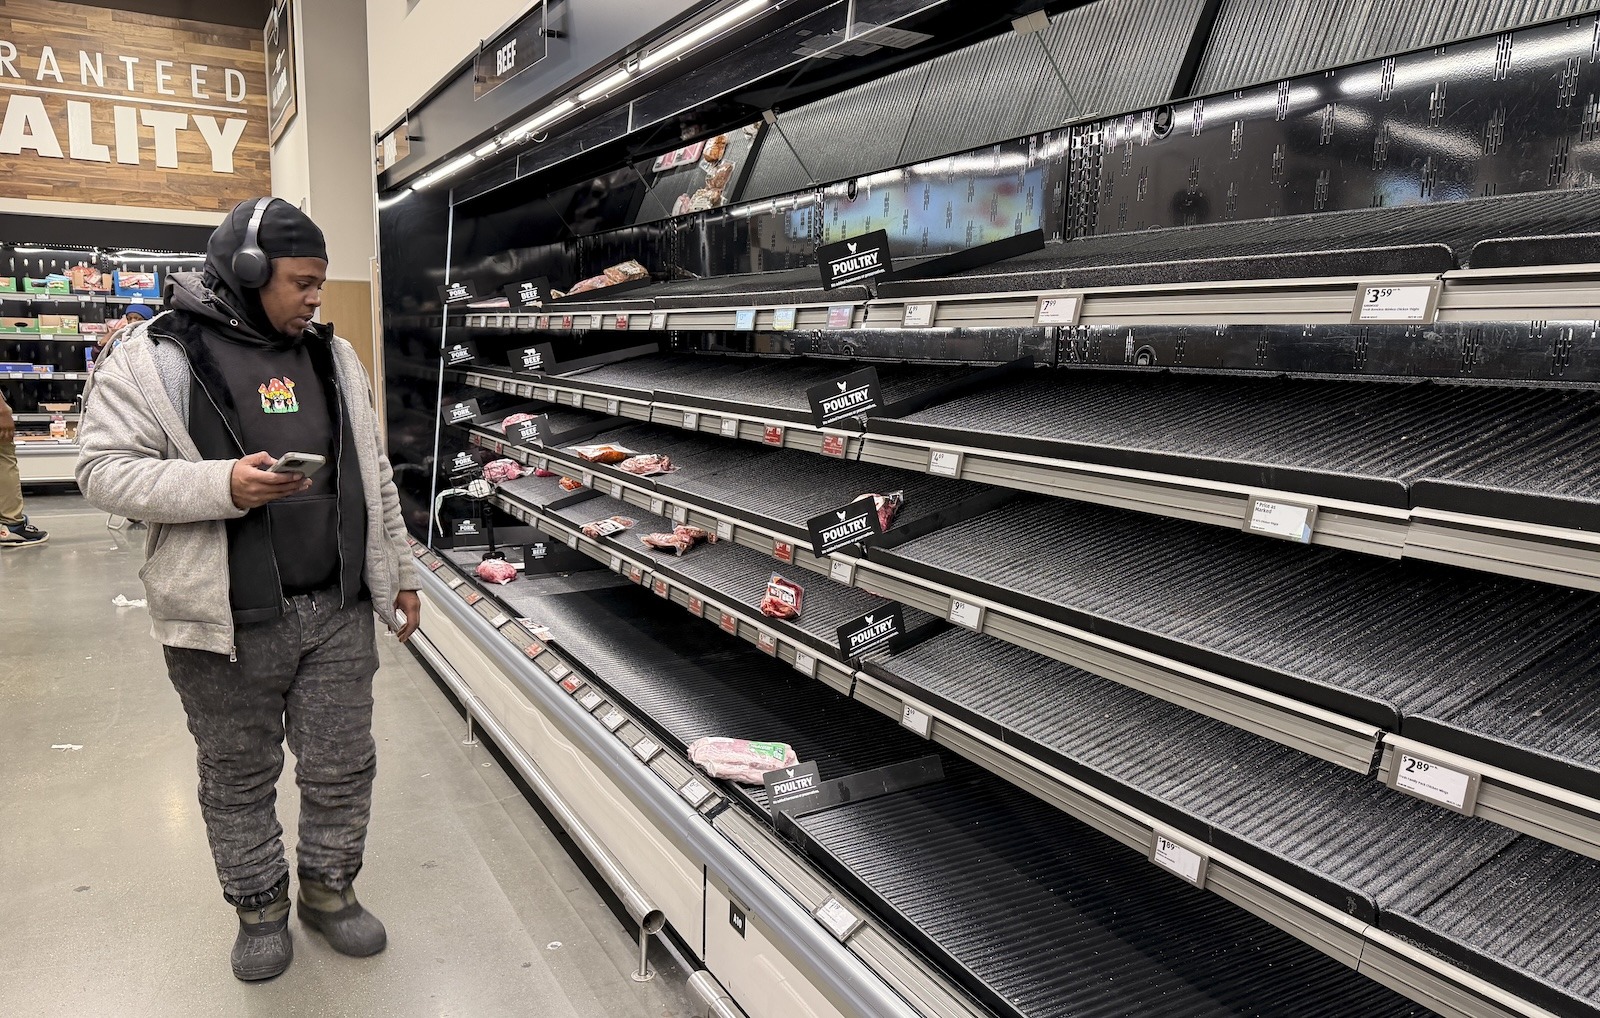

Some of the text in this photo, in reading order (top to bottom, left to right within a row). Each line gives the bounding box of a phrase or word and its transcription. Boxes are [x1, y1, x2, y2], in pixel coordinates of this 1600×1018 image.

[496, 38, 517, 77] BEEF
[0, 40, 247, 103] RANTEED
[0, 94, 248, 173] ALITY
[832, 252, 878, 276] POULTRY
[449, 288, 466, 297] PORK
[520, 290, 538, 300] BEEF
[451, 350, 468, 359] PORK
[524, 355, 541, 364] BEEF
[823, 388, 868, 414] POULTRY
[453, 408, 470, 417] PORK
[520, 428, 537, 437] BEEF
[455, 457, 472, 466] PORK
[822, 517, 866, 543] POULTRY
[851, 619, 892, 646] POULTRY
[774, 777, 812, 794] POULTRY
